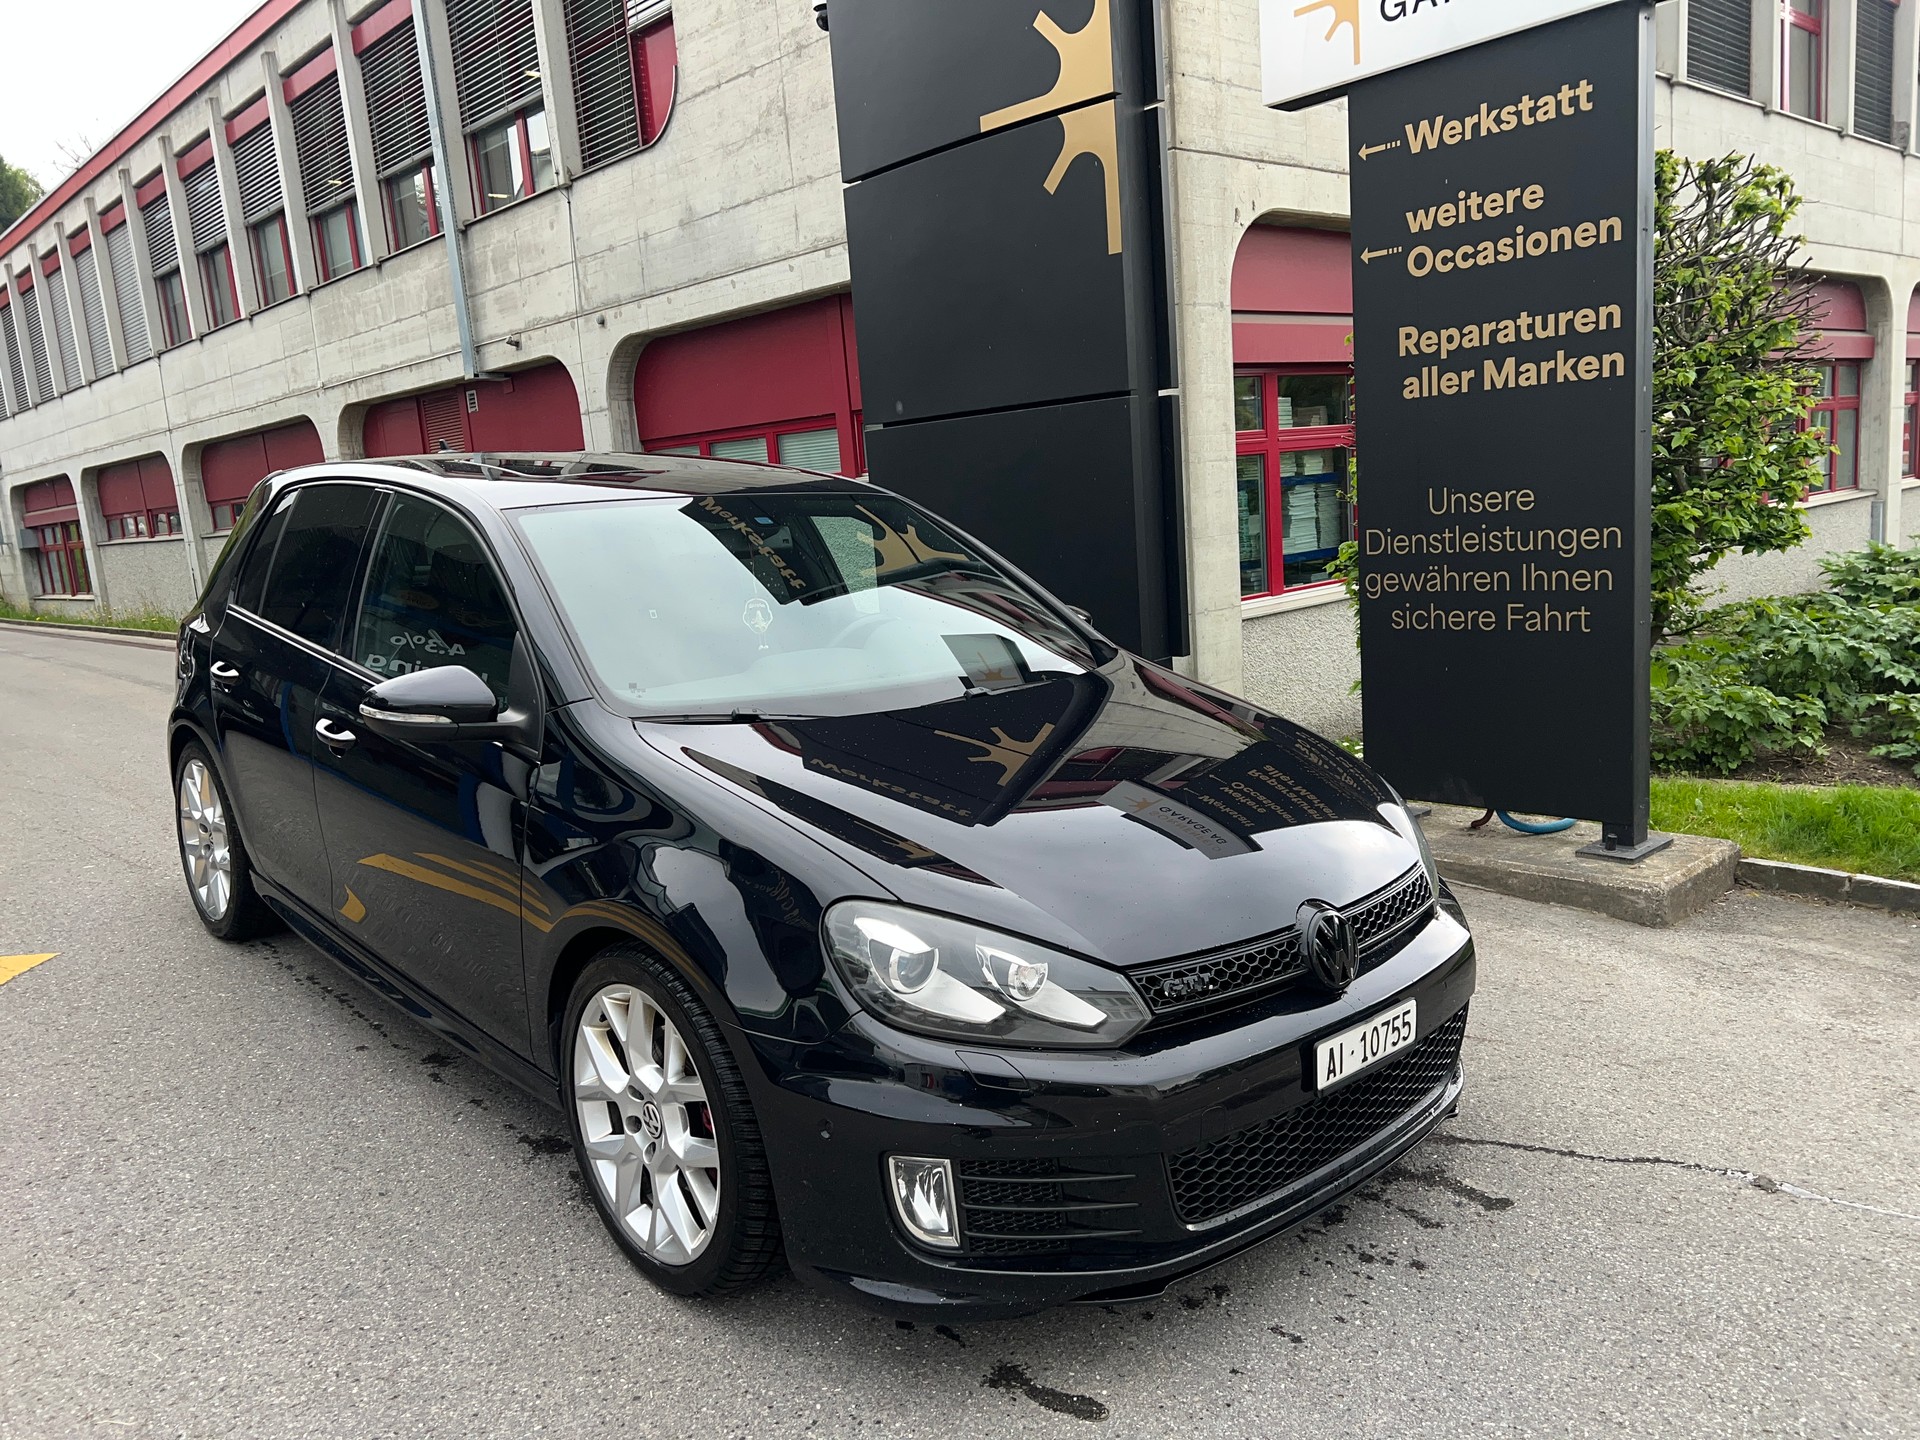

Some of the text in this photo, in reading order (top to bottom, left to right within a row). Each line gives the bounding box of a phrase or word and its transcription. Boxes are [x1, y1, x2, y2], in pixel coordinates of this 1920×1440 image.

[1405, 79, 1594, 154] Werkstatt
[1405, 183, 1545, 233] weitere
[1406, 215, 1623, 277] Occasionen
[1398, 303, 1622, 359] Reparaturen
[1402, 350, 1625, 400] aller Marken
[1428, 487, 1536, 515] Unsere
[1365, 524, 1622, 558] Dienstleistungen
[1365, 562, 1614, 599] gewähren Ihnen
[1391, 602, 1591, 633] sichere Fahrt
[1163, 972, 1213, 997] GTI
